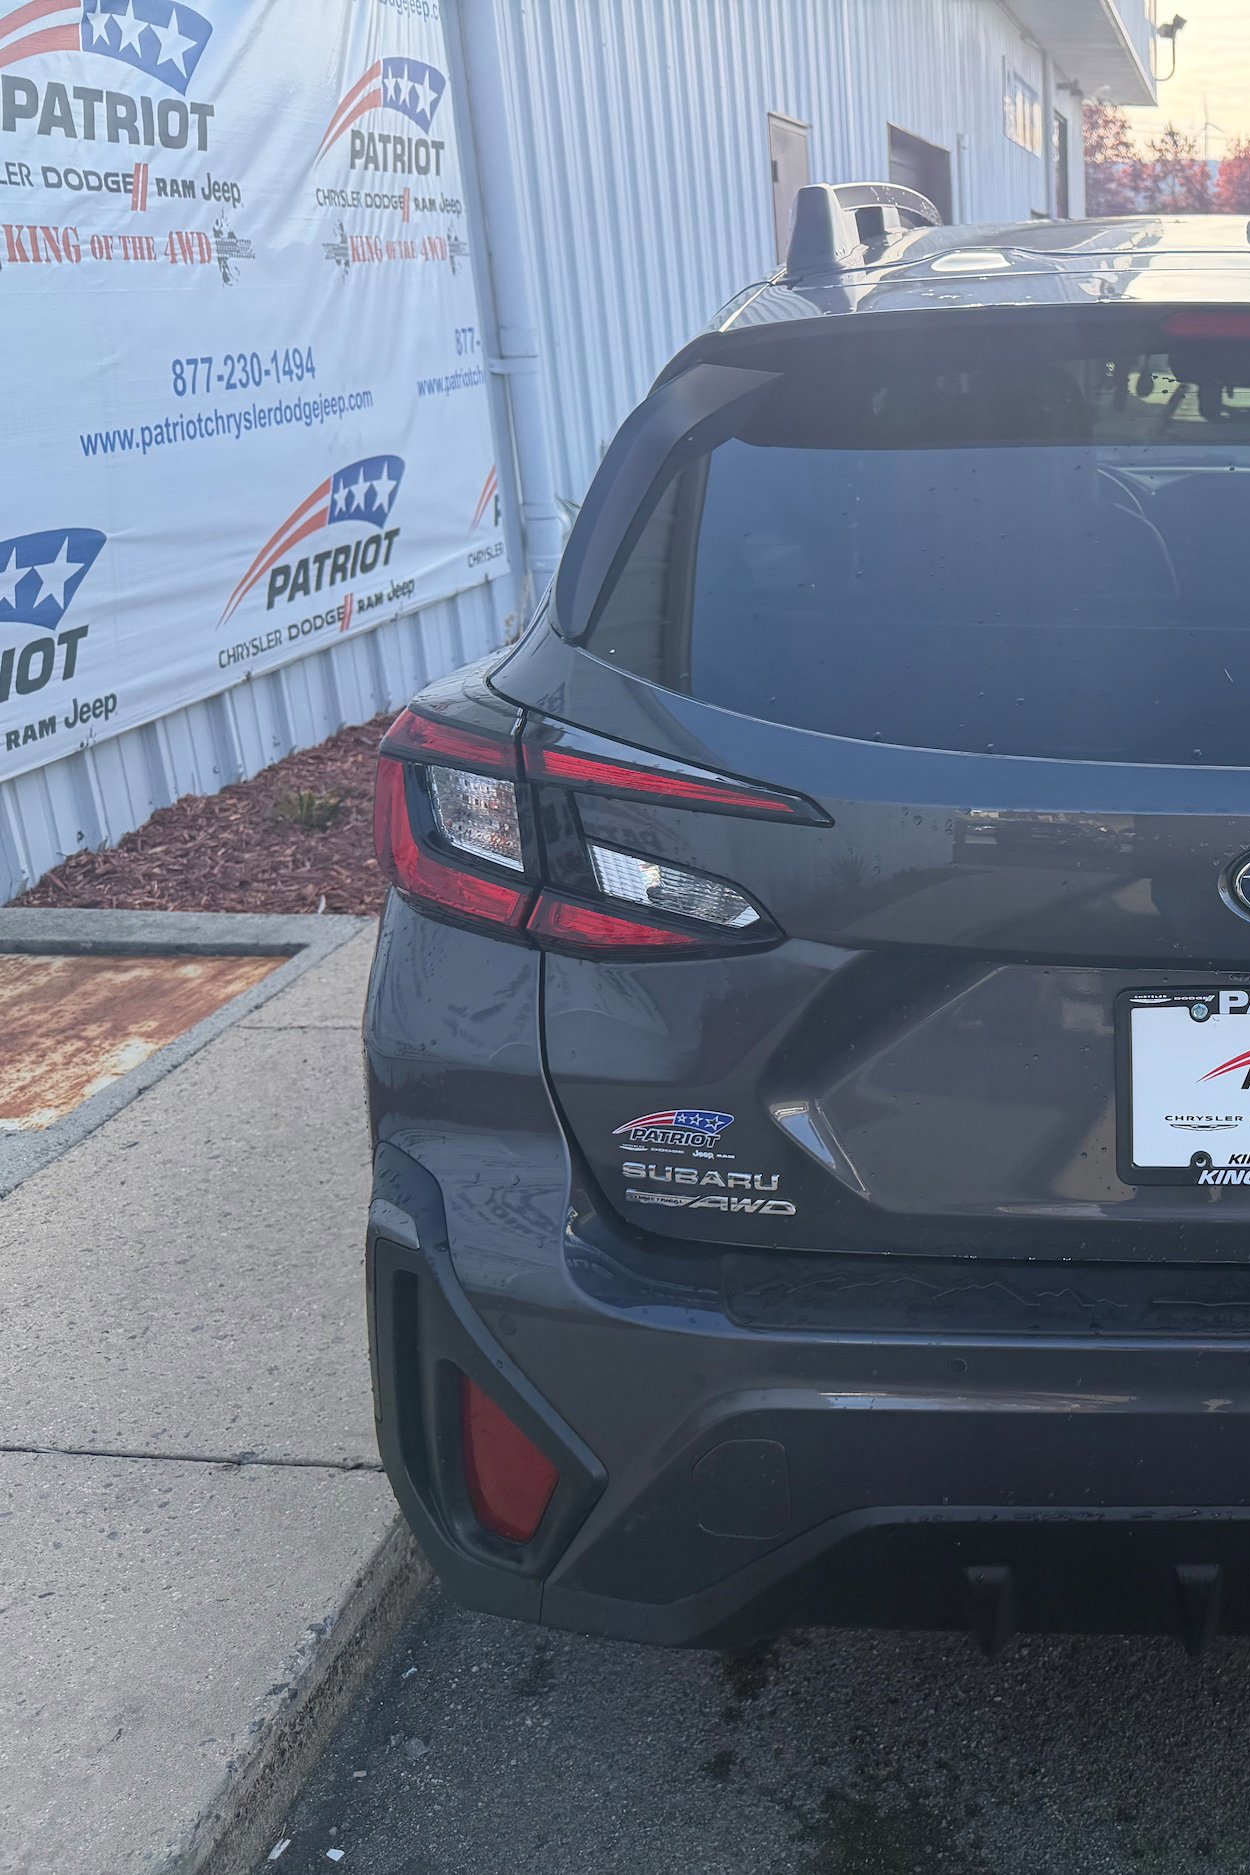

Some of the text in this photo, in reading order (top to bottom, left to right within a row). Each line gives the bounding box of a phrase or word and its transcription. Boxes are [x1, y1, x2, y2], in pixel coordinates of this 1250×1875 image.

[1, 74, 215, 152] PATRIOT
[350, 129, 445, 177] PATRIOT
[41, 166, 134, 193] DODGE
[155, 177, 196, 199] RAM
[201, 172, 242, 208] Jeep
[316, 188, 462, 218] CHRYSLER DODGE RAM Jeep
[2, 224, 212, 264] KING OF THE 4WD
[350, 236, 448, 263] KING OF THE 4WD
[455, 327, 481, 356] 877-
[172, 346, 316, 397] 877-230-1494
[80, 389, 374, 456] www.patriotchryslerdodgejeep.com
[266, 527, 400, 611] PATRIOT
[218, 578, 415, 669] CHRYSLER DODGE RAM Jeep
[6, 693, 117, 752] RAM Jeep
[630, 1128, 720, 1148] PATRIOT
[692, 1149, 714, 1159] Jeep
[622, 1161, 779, 1191] SUBARU
[687, 1195, 797, 1217] AWD
